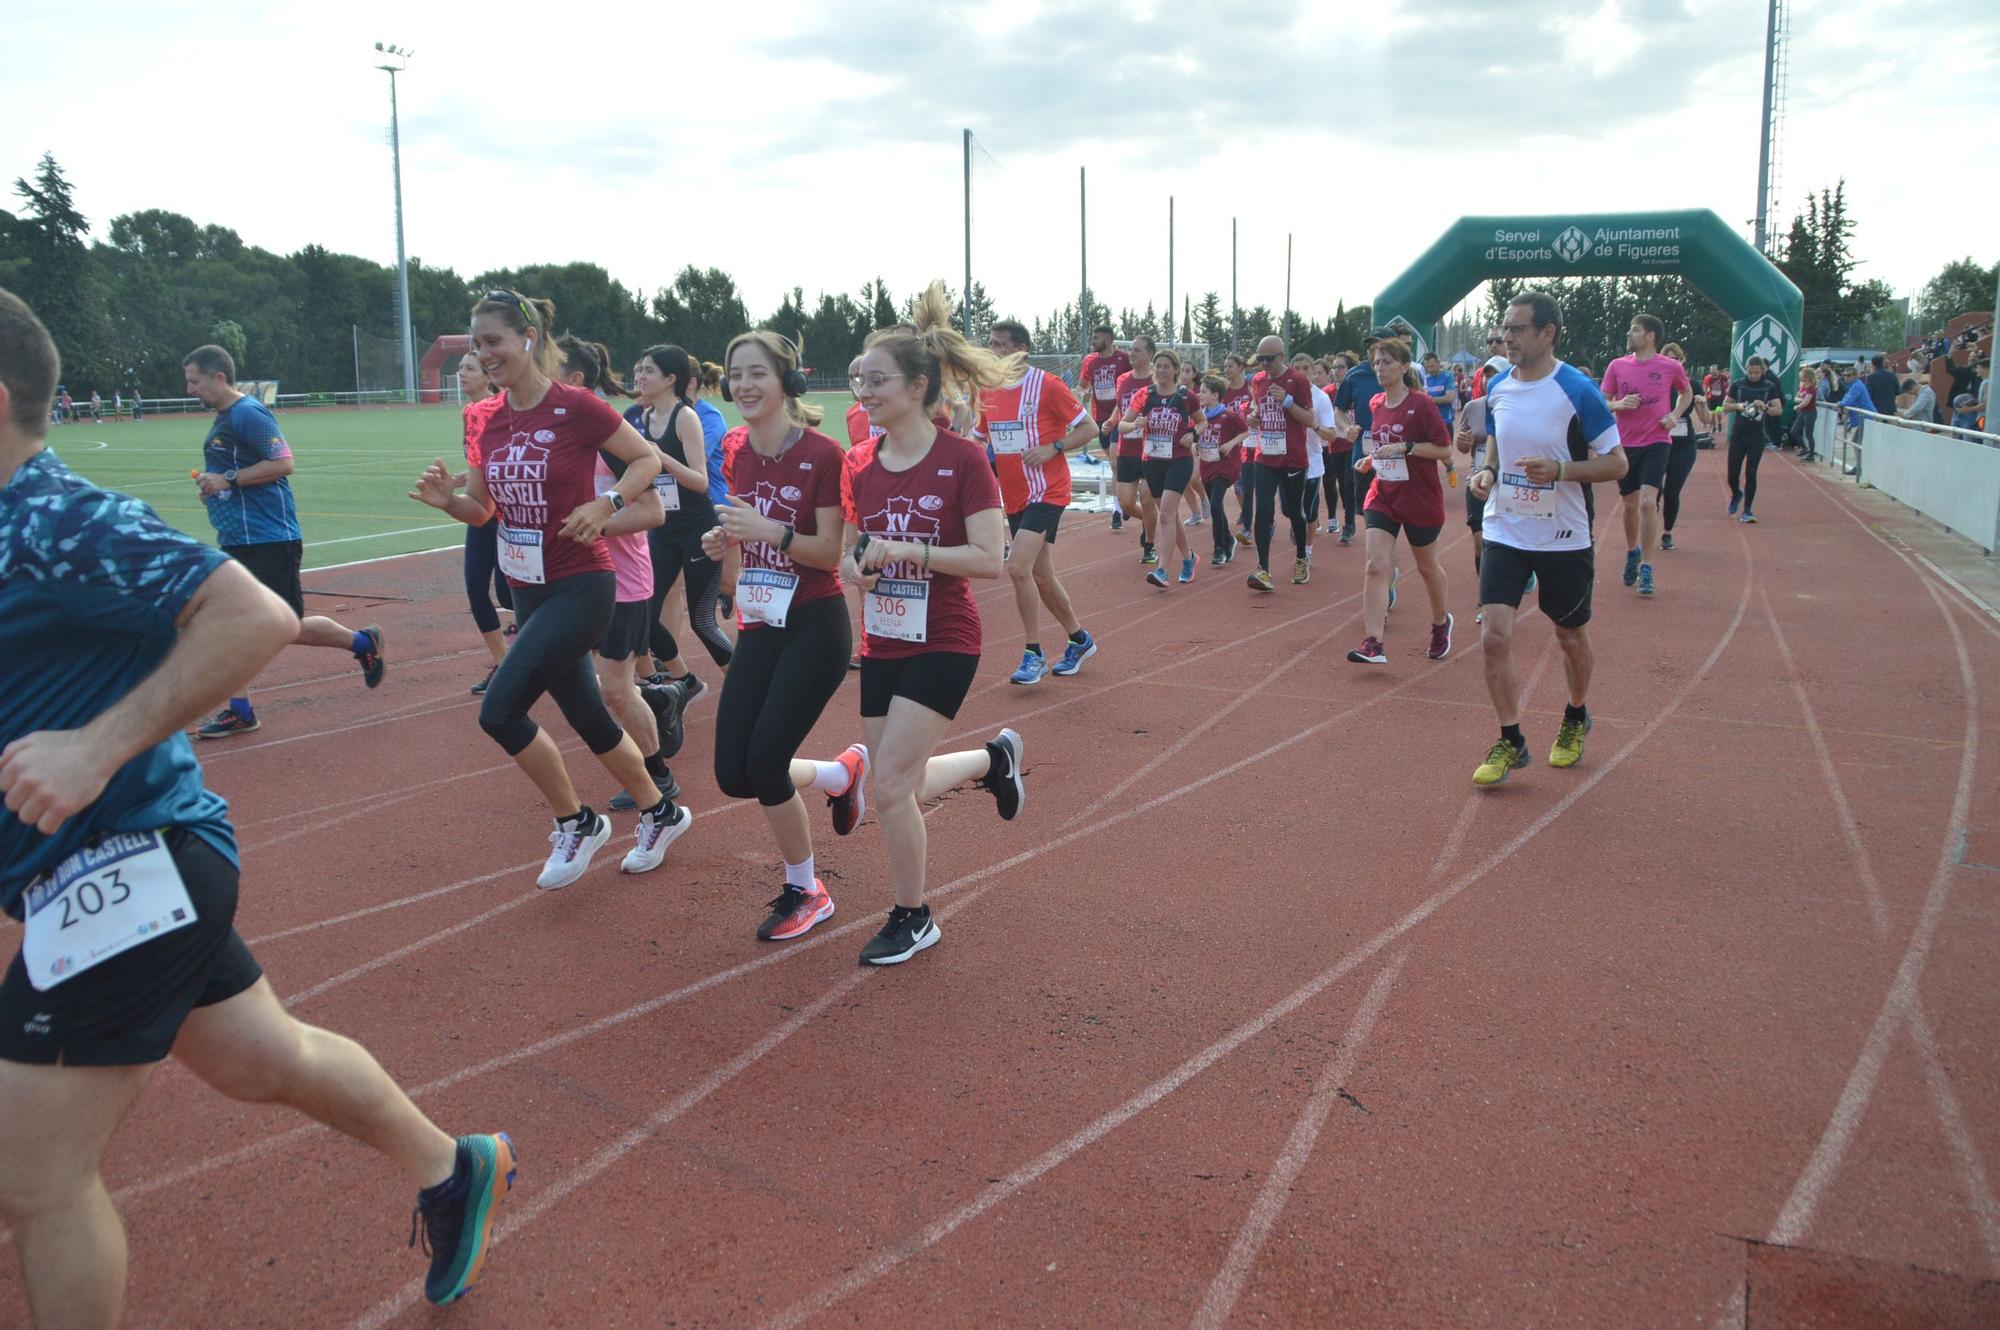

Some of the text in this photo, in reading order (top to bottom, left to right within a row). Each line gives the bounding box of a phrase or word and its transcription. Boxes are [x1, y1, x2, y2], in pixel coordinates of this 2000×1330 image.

[1495, 229, 1541, 242] Servei
[1594, 226, 1681, 244] Ajuntament
[1485, 246, 1552, 262] d'Esports
[1594, 243, 1681, 260] de Figueres
[997, 430, 1014, 441] 151
[506, 445, 527, 462] XV
[488, 464, 541, 480] RUN
[488, 482, 548, 506] CASTELL
[1512, 486, 1540, 502] 338
[754, 495, 774, 517] XV
[886, 512, 911, 533] XV
[882, 560, 933, 580] STELL
[763, 573, 792, 587] CASTELL
[747, 585, 774, 604] 305
[891, 584, 923, 597] CASTELL
[875, 596, 906, 617] 306
[880, 618, 903, 628] ELENA
[84, 832, 151, 866] CASTELL
[57, 868, 131, 931] 203
